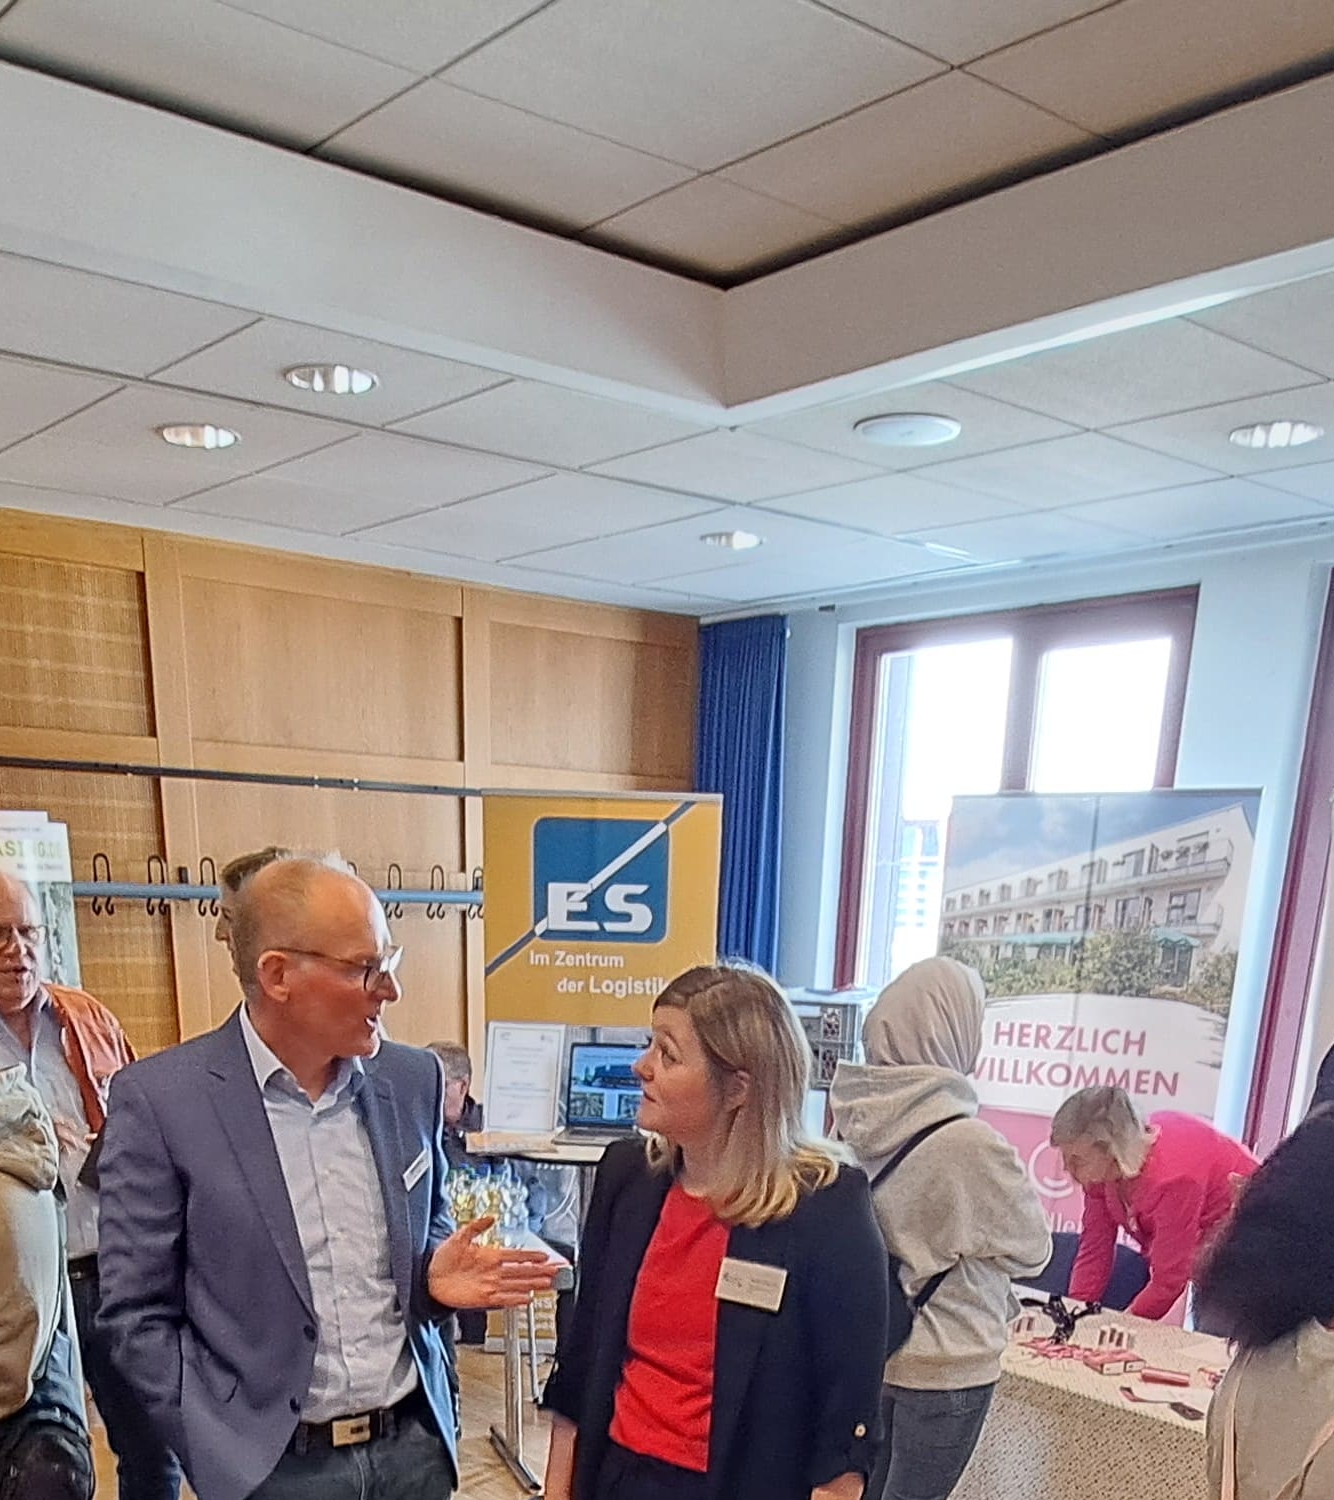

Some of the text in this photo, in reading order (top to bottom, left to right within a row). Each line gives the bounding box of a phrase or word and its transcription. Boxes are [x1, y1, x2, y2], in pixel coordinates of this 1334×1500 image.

[546, 882, 653, 934] ES
[529, 950, 625, 968] Im Zentrum
[557, 977, 585, 993] der
[993, 1020, 1147, 1057] HERZLICH
